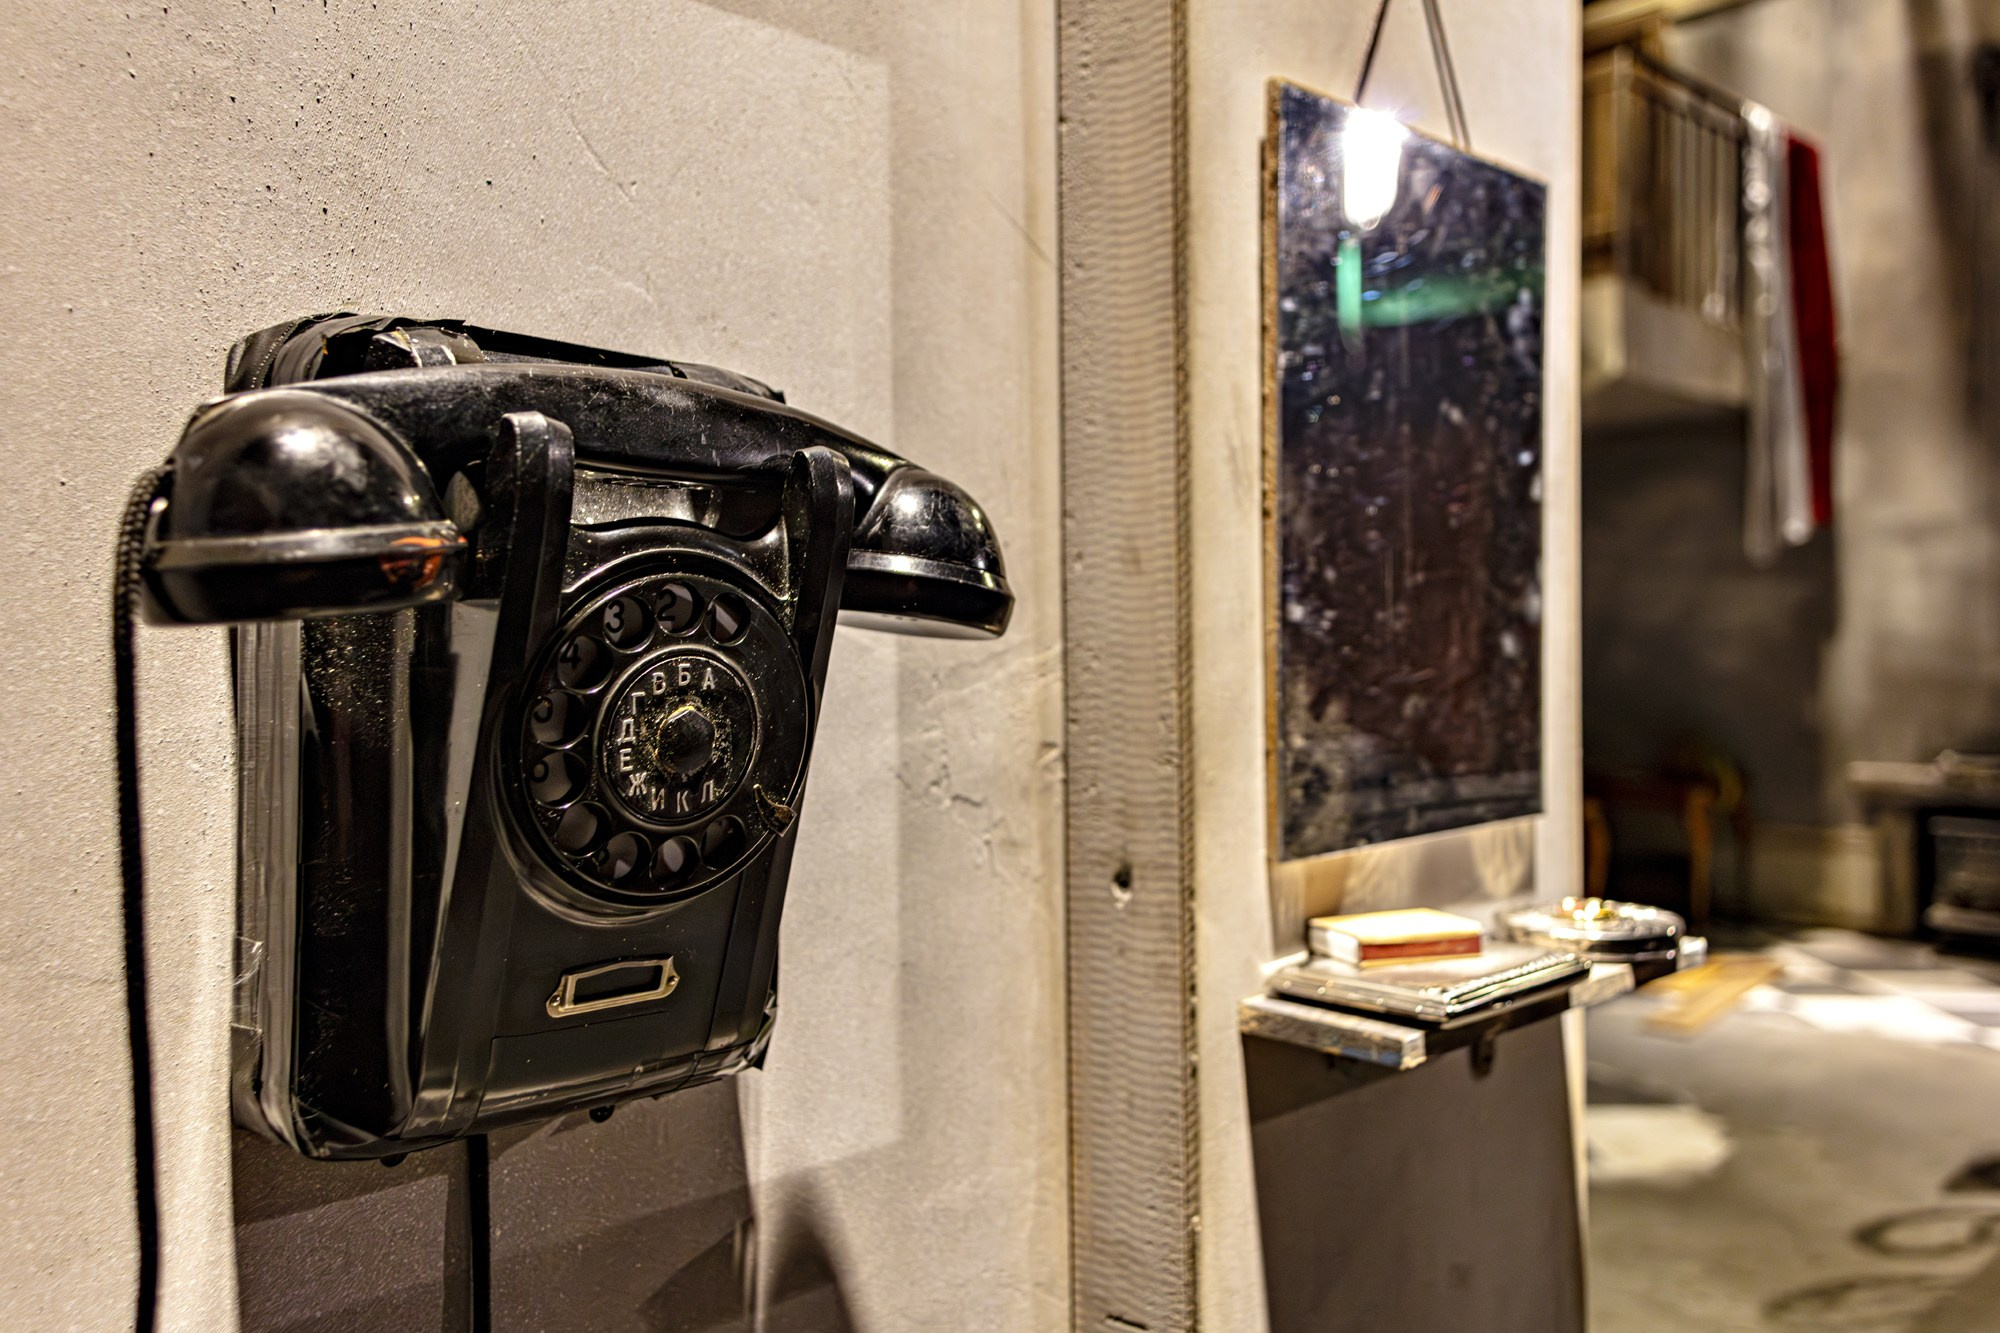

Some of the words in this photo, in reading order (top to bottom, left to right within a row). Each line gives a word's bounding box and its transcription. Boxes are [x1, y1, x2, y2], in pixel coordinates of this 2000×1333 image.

[606, 599, 625, 633] 3
[657, 588, 677, 622] 2
[559, 639, 582, 670] 4
[652, 671, 667, 695] В
[678, 663, 691, 686] Б
[702, 667, 716, 690] А
[631, 691, 646, 715] Г
[617, 718, 636, 745] Д
[619, 748, 634, 772] Е
[628, 772, 647, 796] Ж
[701, 779, 715, 804] Л
[651, 788, 665, 811] И
[676, 790, 690, 813] К
